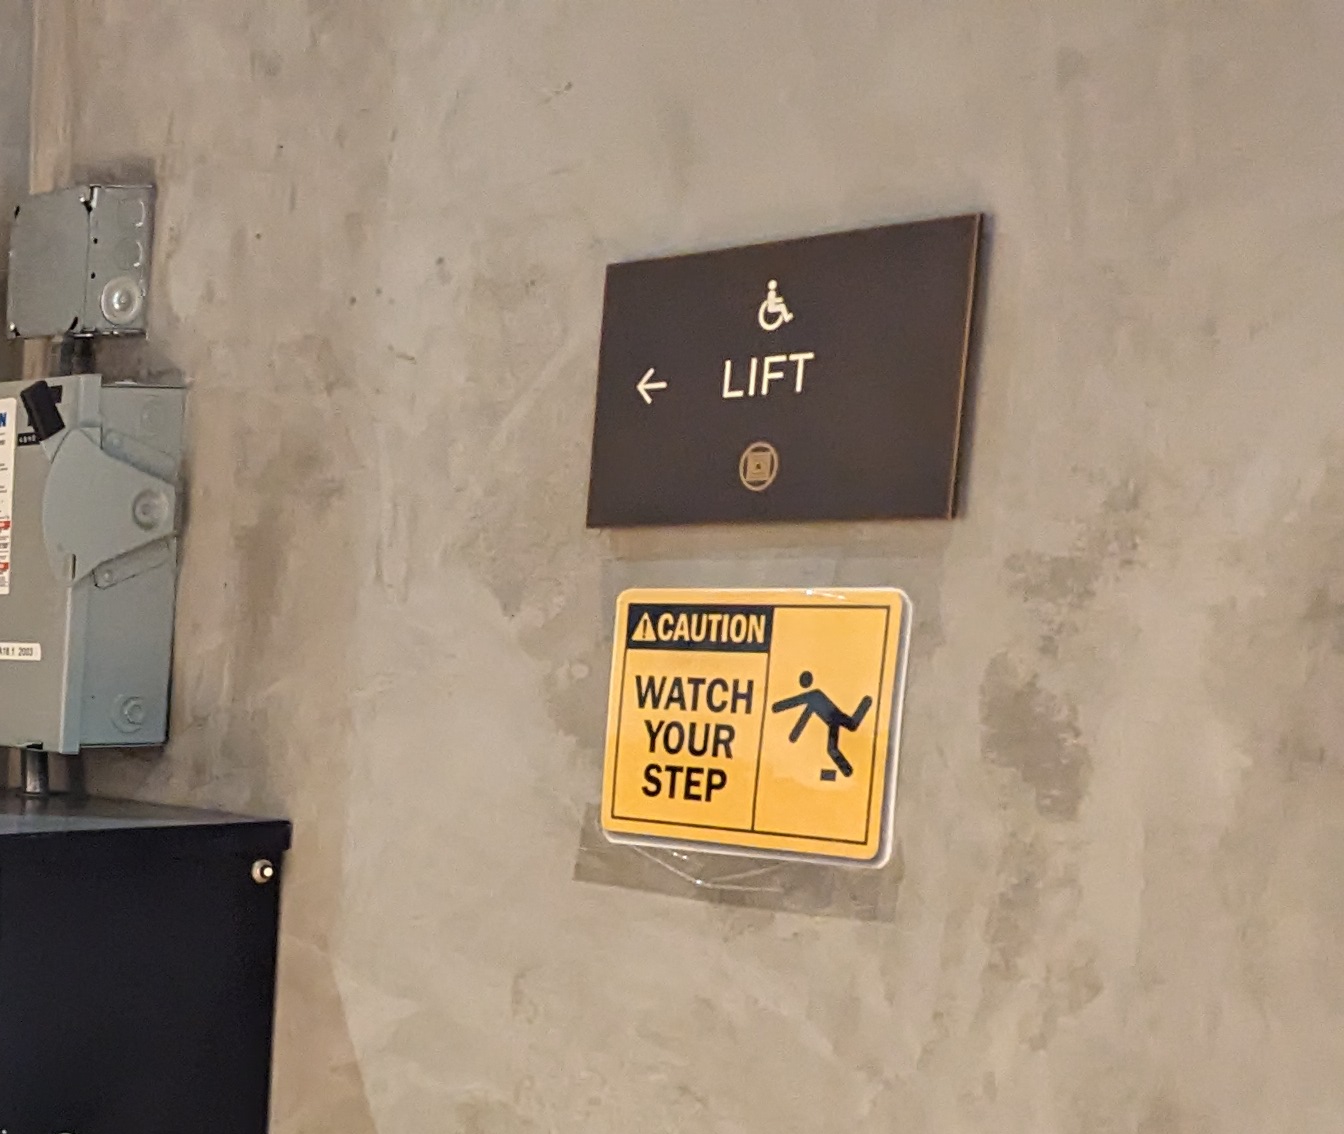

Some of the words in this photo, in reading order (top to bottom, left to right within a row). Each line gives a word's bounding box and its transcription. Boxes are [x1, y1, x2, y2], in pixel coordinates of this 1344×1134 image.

[722, 351, 815, 398] LIFT
[657, 613, 766, 643] CAUTION
[635, 674, 754, 714] WATCH
[644, 719, 736, 759] YOUR
[641, 763, 727, 802] STEP
